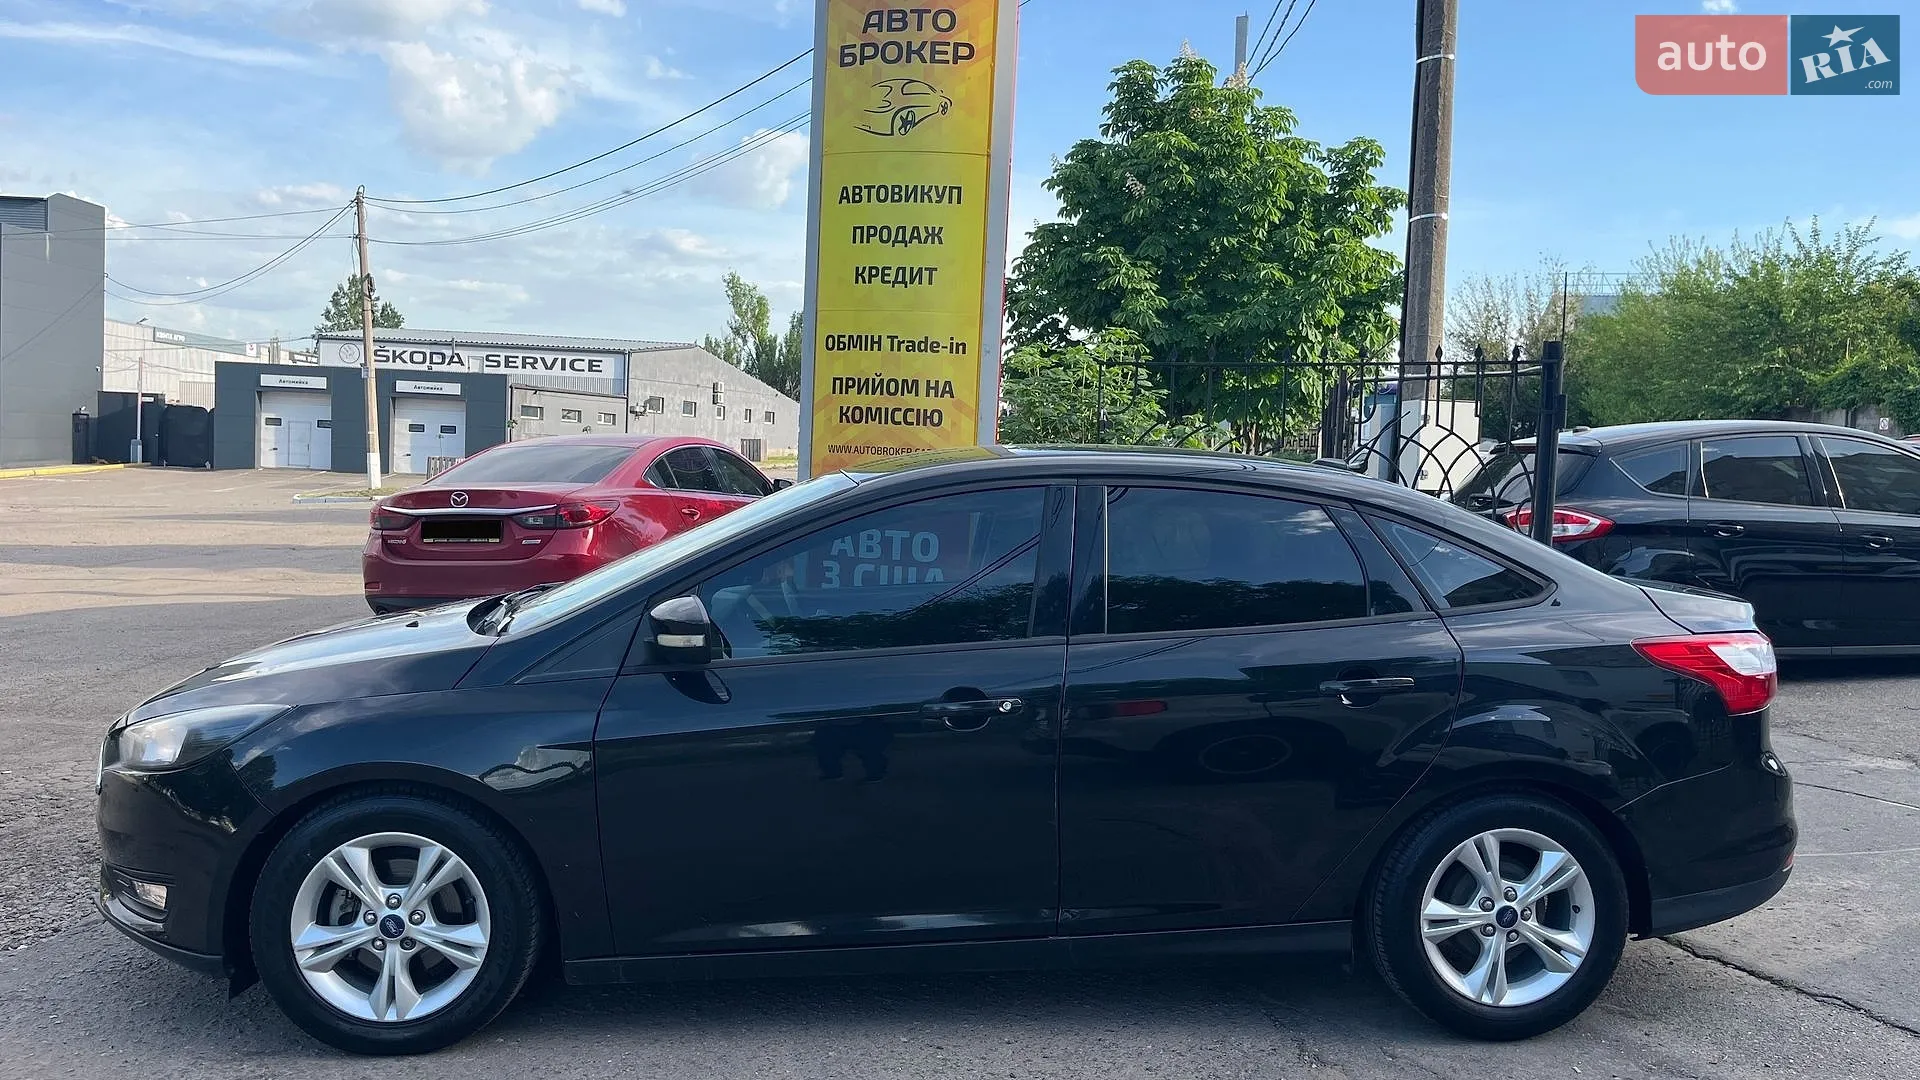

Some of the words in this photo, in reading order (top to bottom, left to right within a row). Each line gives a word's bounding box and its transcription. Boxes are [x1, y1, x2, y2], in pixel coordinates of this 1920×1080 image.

[862, 8, 957, 34] АВТО
[839, 41, 976, 67] БРОКЕР
[838, 184, 963, 205] АВТОВИКУП
[852, 225, 944, 247] ПРОДАЖ
[854, 266, 938, 288] КРЕДИТ
[825, 334, 882, 352] ОБМІН
[887, 335, 967, 355] Trade-in
[374, 345, 465, 367] ŠKODA
[485, 353, 603, 373] SERVICE
[832, 373, 919, 397] ПРИЙОМ
[925, 379, 955, 399] НА
[839, 405, 943, 428] КОМІССІЮ
[830, 529, 940, 563] АВТО
